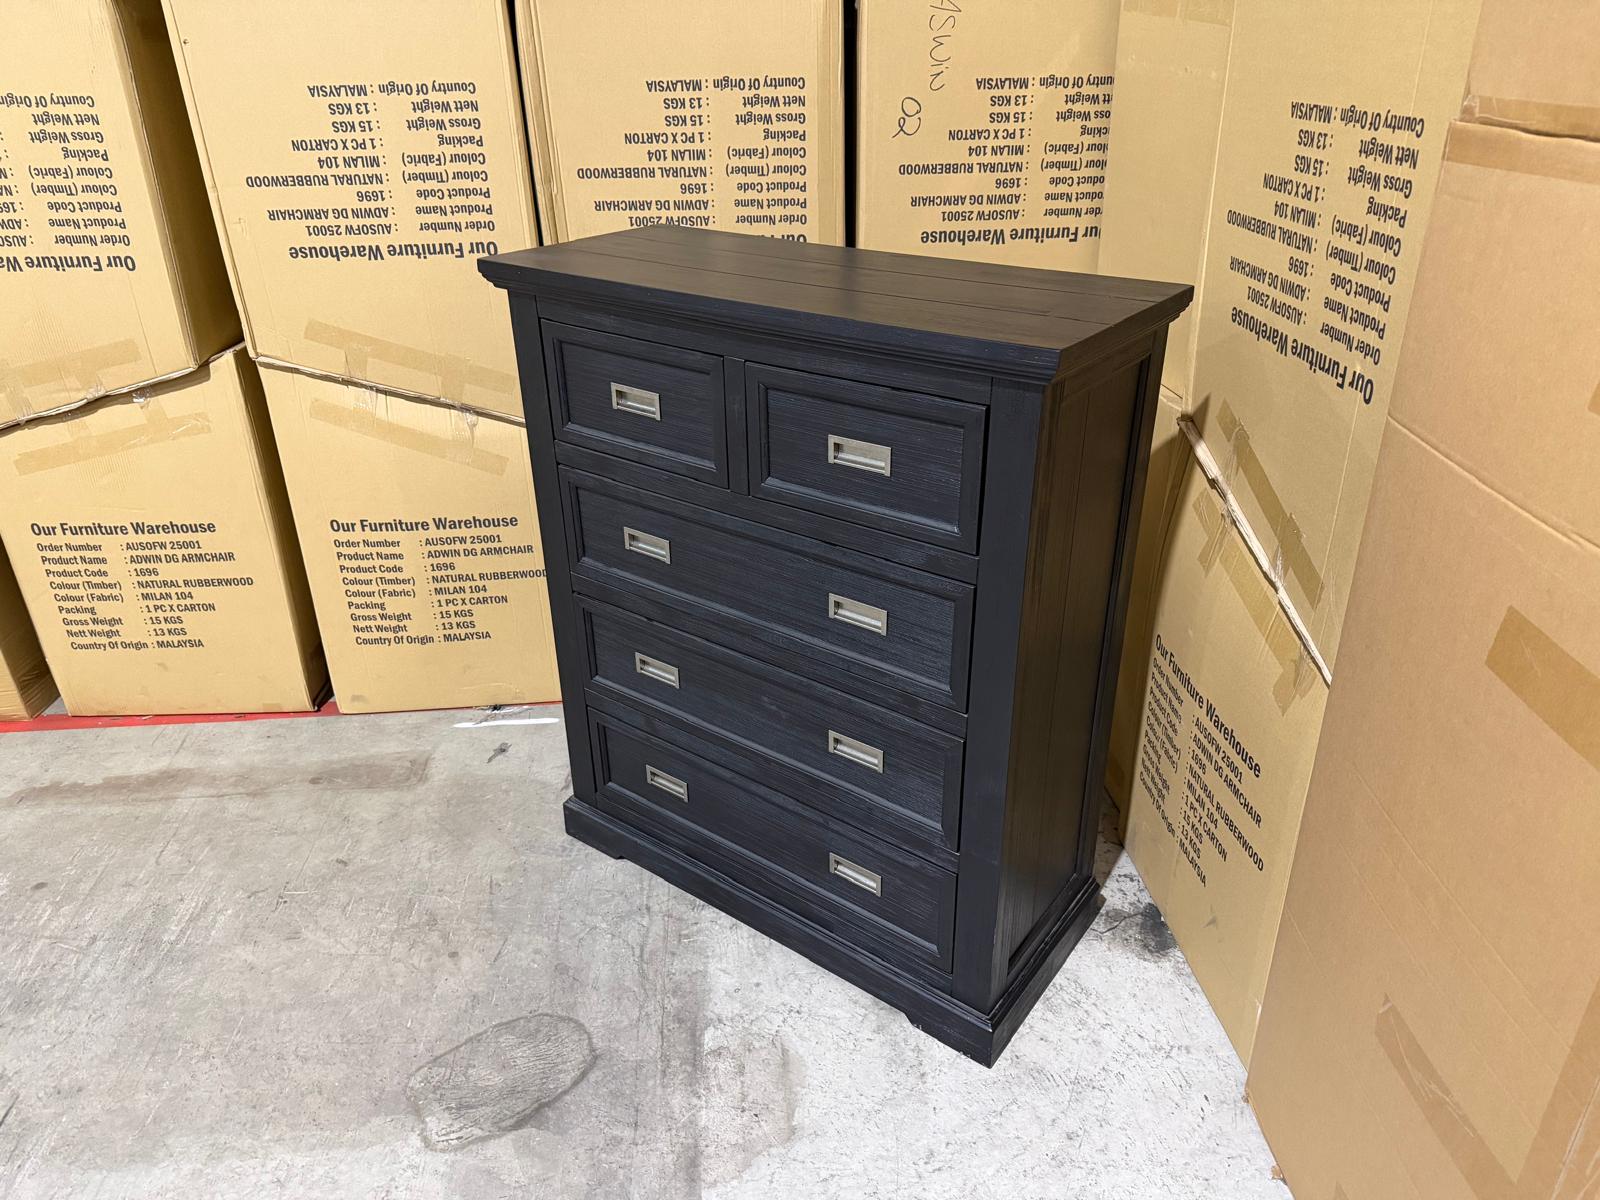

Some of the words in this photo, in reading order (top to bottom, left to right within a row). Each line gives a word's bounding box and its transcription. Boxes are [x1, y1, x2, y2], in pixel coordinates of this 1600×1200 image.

[377, 80, 414, 96] Origin
[415, 82, 429, 96] Of
[431, 79, 477, 95] Country
[645, 78, 702, 93] MALAYSIA
[712, 75, 746, 92] Origin
[747, 77, 761, 91] Of
[762, 74, 806, 90] Country
[306, 84, 368, 98] MALAYSIA
[34, 95, 48, 109] Of
[50, 92, 95, 108] Country
[410, 98, 453, 114] Weight
[452, 99, 479, 113] Nett
[327, 102, 353, 116] KGS
[354, 102, 371, 115] 13
[1055, 107, 1092, 123] Weight
[1093, 109, 1111, 120] oss
[1290, 101, 1333, 124] MALAYSIA
[31, 110, 74, 126] Weight
[72, 113, 100, 126] Nett
[664, 114, 688, 127] KGS
[689, 114, 704, 127] 15
[734, 110, 774, 126] Weight
[774, 112, 806, 125] Gross
[988, 111, 1011, 124] KGS
[1012, 111, 1026, 123] 15
[1339, 104, 1369, 130] Origin
[1367, 111, 1382, 132] Of
[1381, 109, 1425, 139] Country
[60, 146, 110, 162] Packing
[401, 151, 447, 168] (Fabric)
[448, 152, 486, 166] Colour
[646, 149, 668, 162] 104
[670, 148, 706, 162] MILAN
[726, 144, 770, 160] (Fabric)
[771, 146, 807, 159] Colour
[317, 156, 340, 169] 104
[342, 155, 381, 169] MILAN
[576, 166, 656, 180] RUBBERWOOD
[657, 166, 707, 179] NATURAL
[725, 162, 770, 178] (Timber)
[771, 164, 807, 176] Colour
[679, 182, 708, 195] 1696
[736, 181, 764, 194] Code
[765, 181, 807, 193] Product
[994, 177, 1022, 190] 1696
[1048, 176, 1075, 188] Code
[1076, 175, 1105, 187] oduct
[1262, 172, 1294, 196] CARTON
[356, 189, 386, 203] 1696
[415, 188, 445, 201] Code
[446, 187, 491, 200] Product
[1293, 180, 1302, 199] X
[1300, 182, 1314, 202] PC
[1314, 185, 1321, 203] 1
[415, 205, 448, 217] Name
[448, 203, 493, 217] Product
[593, 199, 653, 212] ARMCHAIR
[654, 199, 671, 211] DG
[673, 199, 710, 211] ADWIN
[733, 198, 764, 210] Name
[765, 197, 807, 210] Product
[266, 208, 329, 221] ARMCHAIR
[331, 207, 349, 220] DG
[350, 206, 389, 219] ADWIN
[1365, 195, 1408, 229] Packing
[1081, 225, 1102, 239] ur
[1226, 209, 1277, 241] RUBBERWOOD
[920, 228, 1006, 246] Warehouse
[1009, 226, 1079, 244] Furniture
[1277, 225, 1314, 254] NATURAL
[288, 244, 385, 262] Warehouse
[386, 242, 465, 260] Furniture
[468, 241, 498, 256] Our
[1325, 239, 1364, 273] (Timber)
[23, 255, 103, 272] Furniture
[106, 255, 137, 272] Our
[1287, 255, 1310, 278] 1696
[1363, 257, 1396, 286] Colour
[1330, 272, 1353, 297] Code
[1247, 285, 1270, 310] 25001
[1353, 281, 1392, 313] Product
[1269, 296, 1304, 326] AUSOFW
[1231, 306, 1288, 357] Warehouse
[1319, 321, 1355, 353] Number
[1354, 338, 1381, 366] Order
[1290, 338, 1348, 390] Furniture
[1347, 370, 1374, 405] Our
[30, 522, 57, 537] Our
[59, 522, 129, 536] Furniture
[129, 520, 217, 535] Warehouse
[329, 519, 357, 533] Our
[359, 518, 430, 533] Furniture
[431, 515, 519, 531] Warehouse
[36, 542, 64, 552] Order
[64, 542, 103, 552] Number
[125, 540, 168, 552] AUSOFW
[168, 540, 202, 550] 25001
[333, 538, 361, 548] Order
[361, 538, 401, 548] Number
[424, 535, 468, 547] AUSOFW
[468, 534, 503, 545] 25001
[40, 555, 80, 566] Product
[78, 554, 108, 565] Name
[129, 553, 163, 565] ADWIN
[163, 553, 180, 564] DG
[181, 551, 236, 564] ARMCHAIR
[336, 551, 375, 561] Product
[375, 551, 405, 561] Name
[426, 548, 461, 559] ADWIN
[462, 547, 478, 557] DG
[479, 544, 534, 556] ARMCHAIR
[338, 564, 378, 574] Product
[378, 564, 404, 574] Code
[429, 561, 456, 572] 1696
[49, 580, 81, 590] Colour
[81, 580, 122, 592] (Timber)
[136, 579, 183, 589] NATURAL
[182, 576, 254, 588] RUBBERWOOD
[344, 588, 376, 598] Colour
[377, 588, 416, 600] (Fabric)
[433, 585, 466, 596] MILAN
[468, 584, 488, 594] 104
[57, 605, 97, 616] Packing
[145, 604, 153, 613] 1
[152, 603, 168, 613] PC
[167, 603, 176, 613] X
[176, 602, 216, 613] CARTON
[350, 612, 378, 622] Gross
[377, 612, 413, 623] Weight
[439, 610, 452, 619] 15
[453, 608, 474, 619] KGS
[70, 641, 107, 652] Country
[107, 640, 119, 650] Of
[119, 640, 149, 651] Origin
[155, 638, 205, 649] MALAYSIA
[1155, 633, 1169, 661] Our
[1168, 651, 1204, 710] Furniture
[1205, 697, 1261, 779] Warehouse
[1194, 716, 1222, 757] AUSOFW
[1220, 749, 1243, 785] 25001
[1192, 732, 1214, 766] ADWIN
[1213, 758, 1224, 780] DG
[1222, 773, 1262, 829] ARMCHAIR
